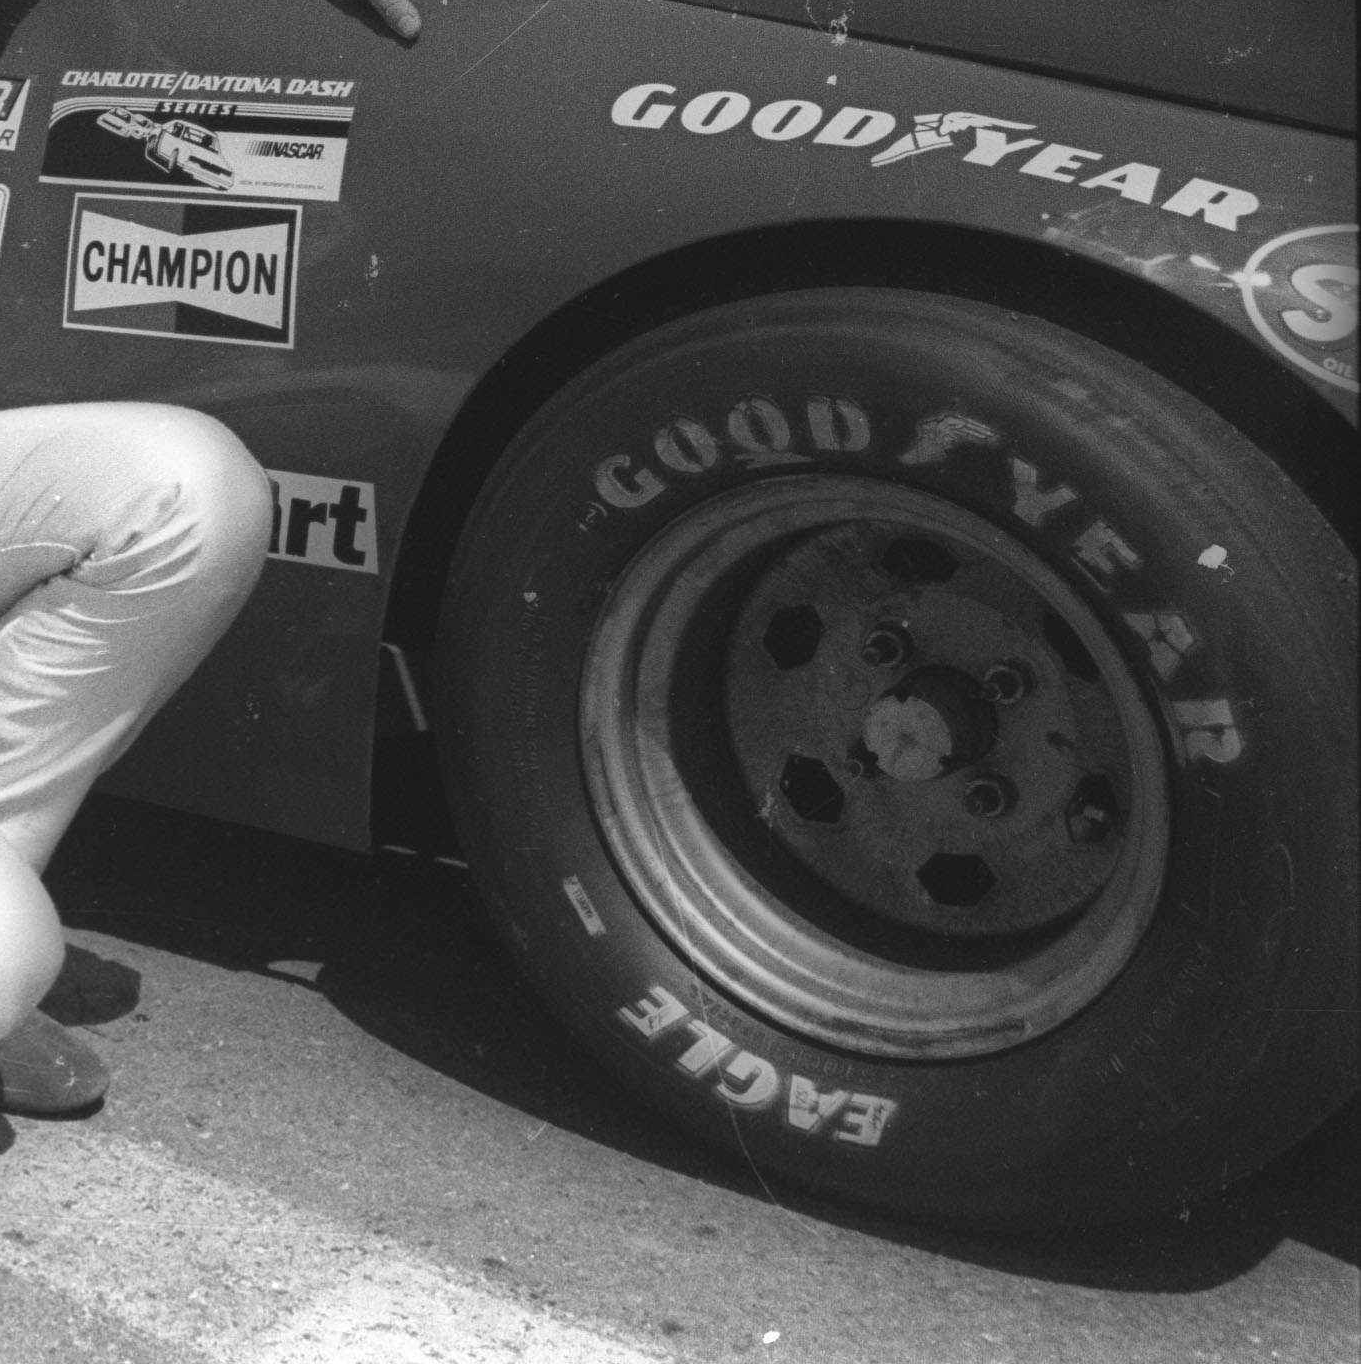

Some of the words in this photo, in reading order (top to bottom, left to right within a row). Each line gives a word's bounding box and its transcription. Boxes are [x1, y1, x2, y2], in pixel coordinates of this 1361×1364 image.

[284, 78, 355, 97] DASH
[160, 102, 235, 115] SERIES
[268, 140, 325, 160] NASCAR
[80, 240, 278, 297] CHAMPION
[615, 982, 899, 1148] EAGLE
